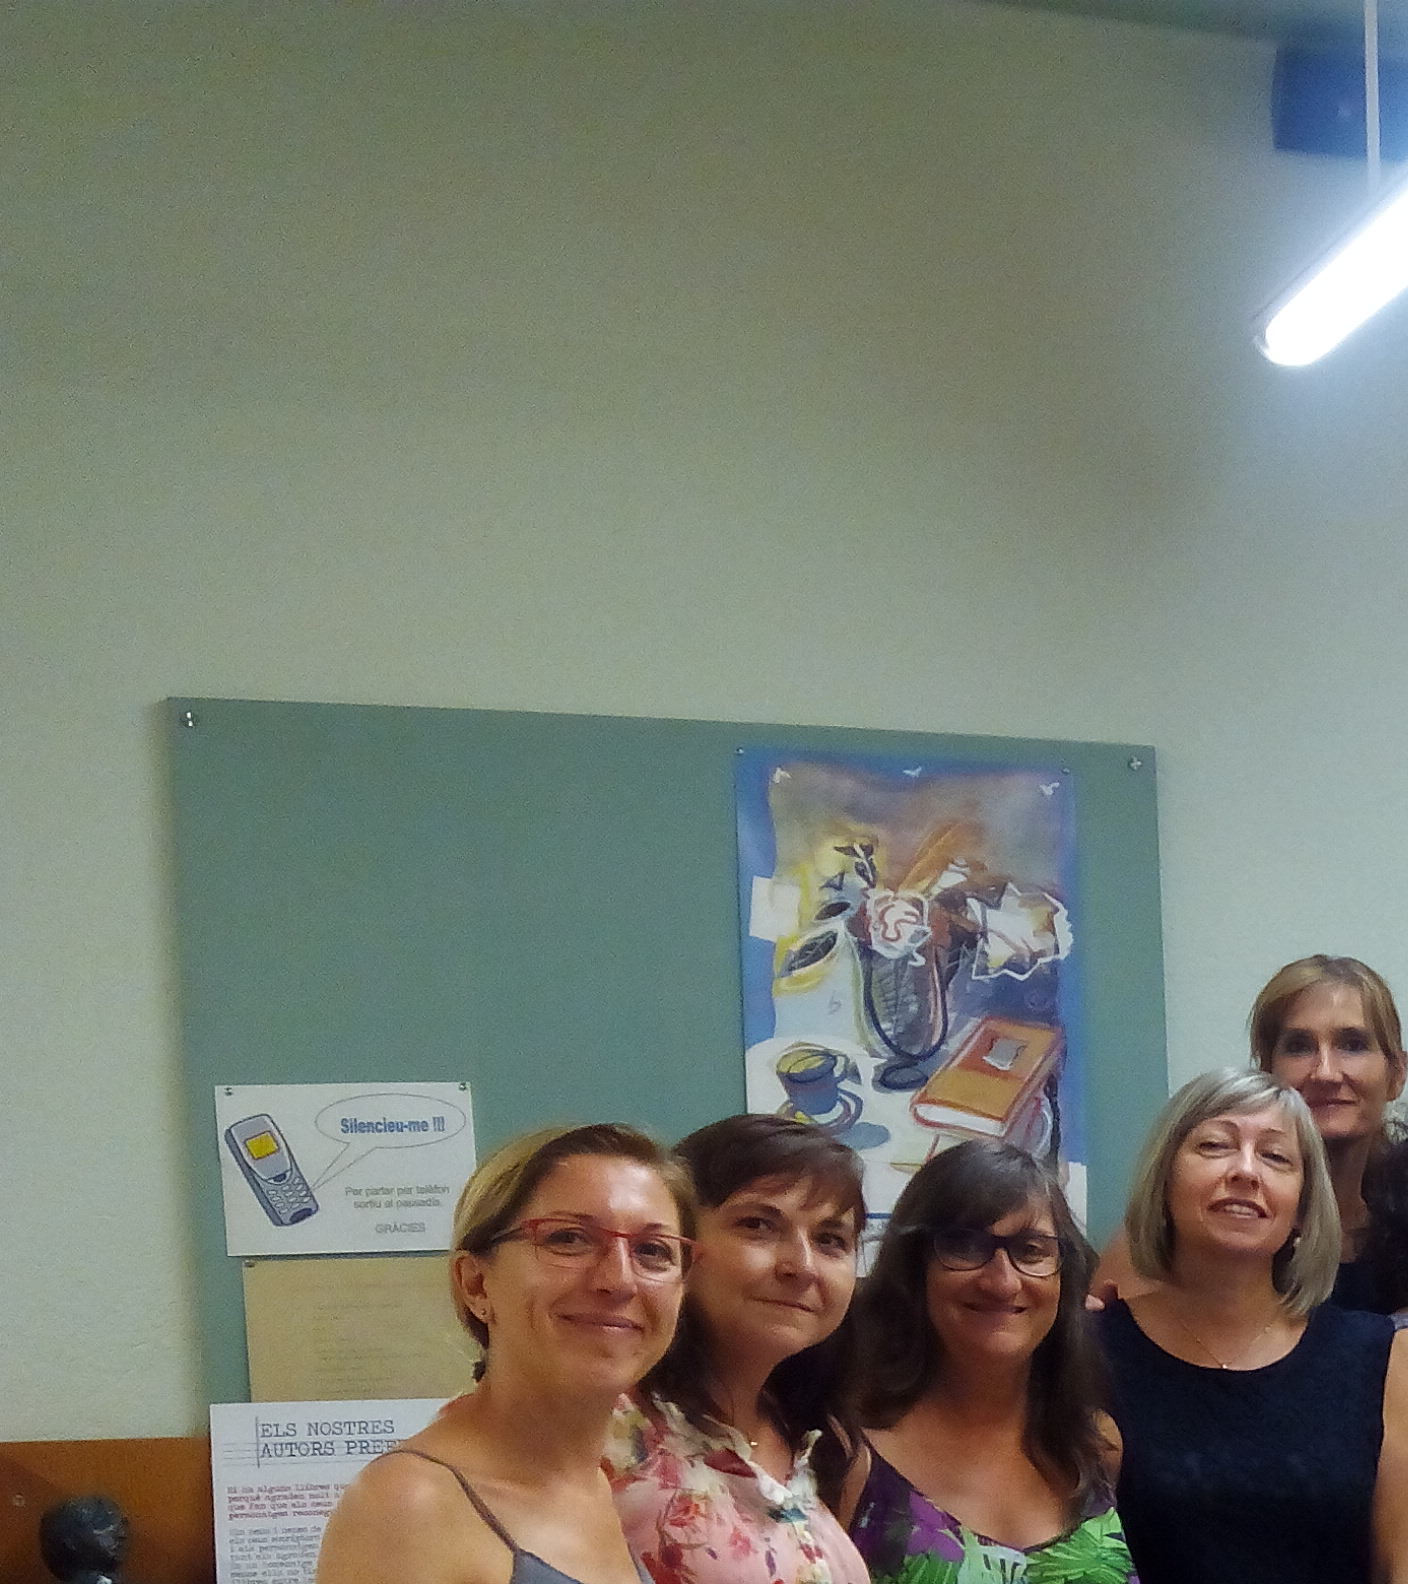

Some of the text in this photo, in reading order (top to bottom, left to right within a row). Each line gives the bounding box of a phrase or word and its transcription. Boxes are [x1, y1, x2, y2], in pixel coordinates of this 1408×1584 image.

[340, 1116, 429, 1134] Silencieu-me
[375, 1221, 426, 1234] GRÀCIES
[260, 1418, 396, 1439] ELS NOSTRES
[259, 1440, 335, 1459] AUTORS
